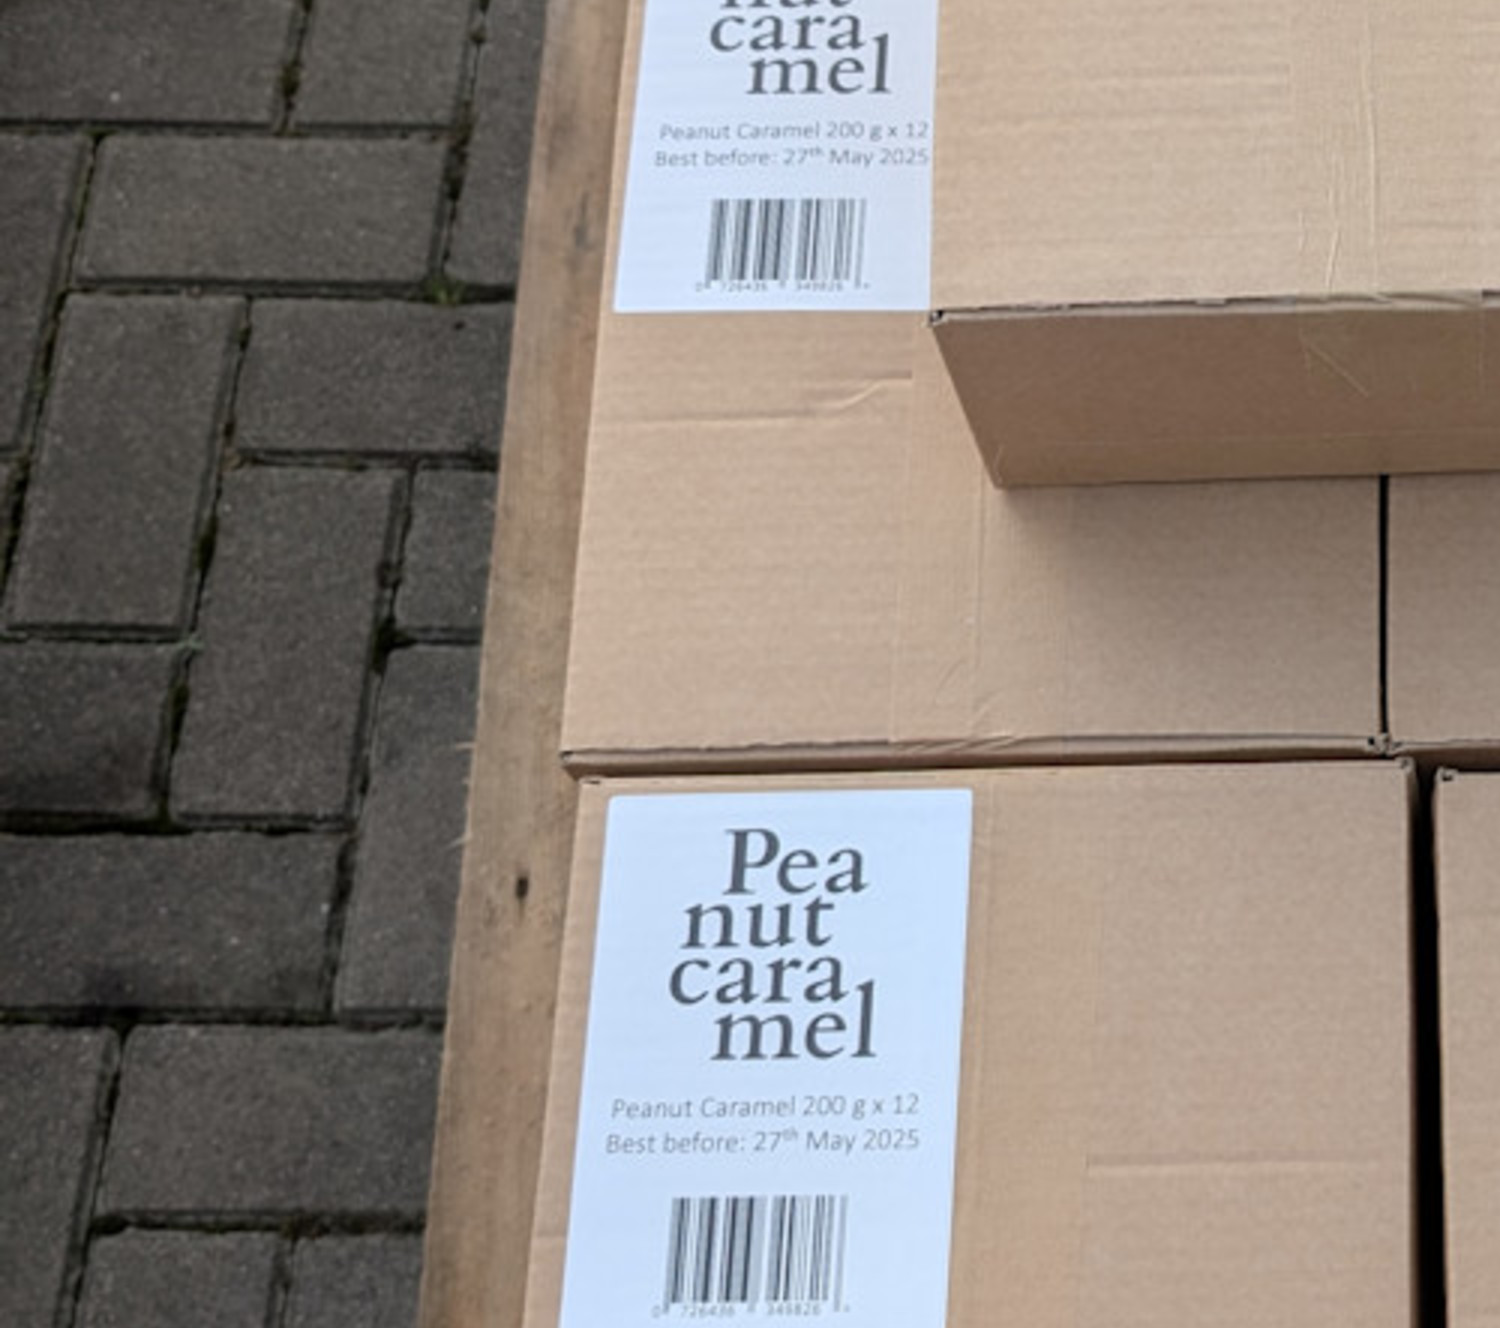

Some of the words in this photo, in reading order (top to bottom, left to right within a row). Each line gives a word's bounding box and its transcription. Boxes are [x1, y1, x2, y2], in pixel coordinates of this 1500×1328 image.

[709, 15, 864, 52] cara
[748, 32, 890, 94] mel
[659, 123, 731, 141] Peanut
[736, 120, 821, 140] Caramel
[826, 120, 865, 140] 200
[869, 125, 883, 142] g
[887, 126, 898, 137] x
[906, 120, 929, 139] 12
[654, 150, 699, 168] Best
[703, 147, 778, 167] before:
[782, 146, 825, 167] 27th
[828, 148, 874, 168] May
[878, 147, 930, 166] 2025
[721, 829, 869, 895] Pea
[681, 894, 835, 949] nut
[669, 957, 849, 1005] cara
[711, 978, 877, 1060] mel
[610, 1098, 693, 1120] Peanut
[699, 1095, 796, 1119] Caramel
[802, 1094, 847, 1117] 200
[851, 1098, 866, 1121] g
[872, 1099, 883, 1115] x
[893, 1092, 920, 1116] 12
[605, 1133, 657, 1155] Best
[662, 1130, 746, 1154] before:
[752, 1126, 799, 1153] 27th
[805, 1129, 856, 1156] May
[862, 1127, 920, 1151] 2025
